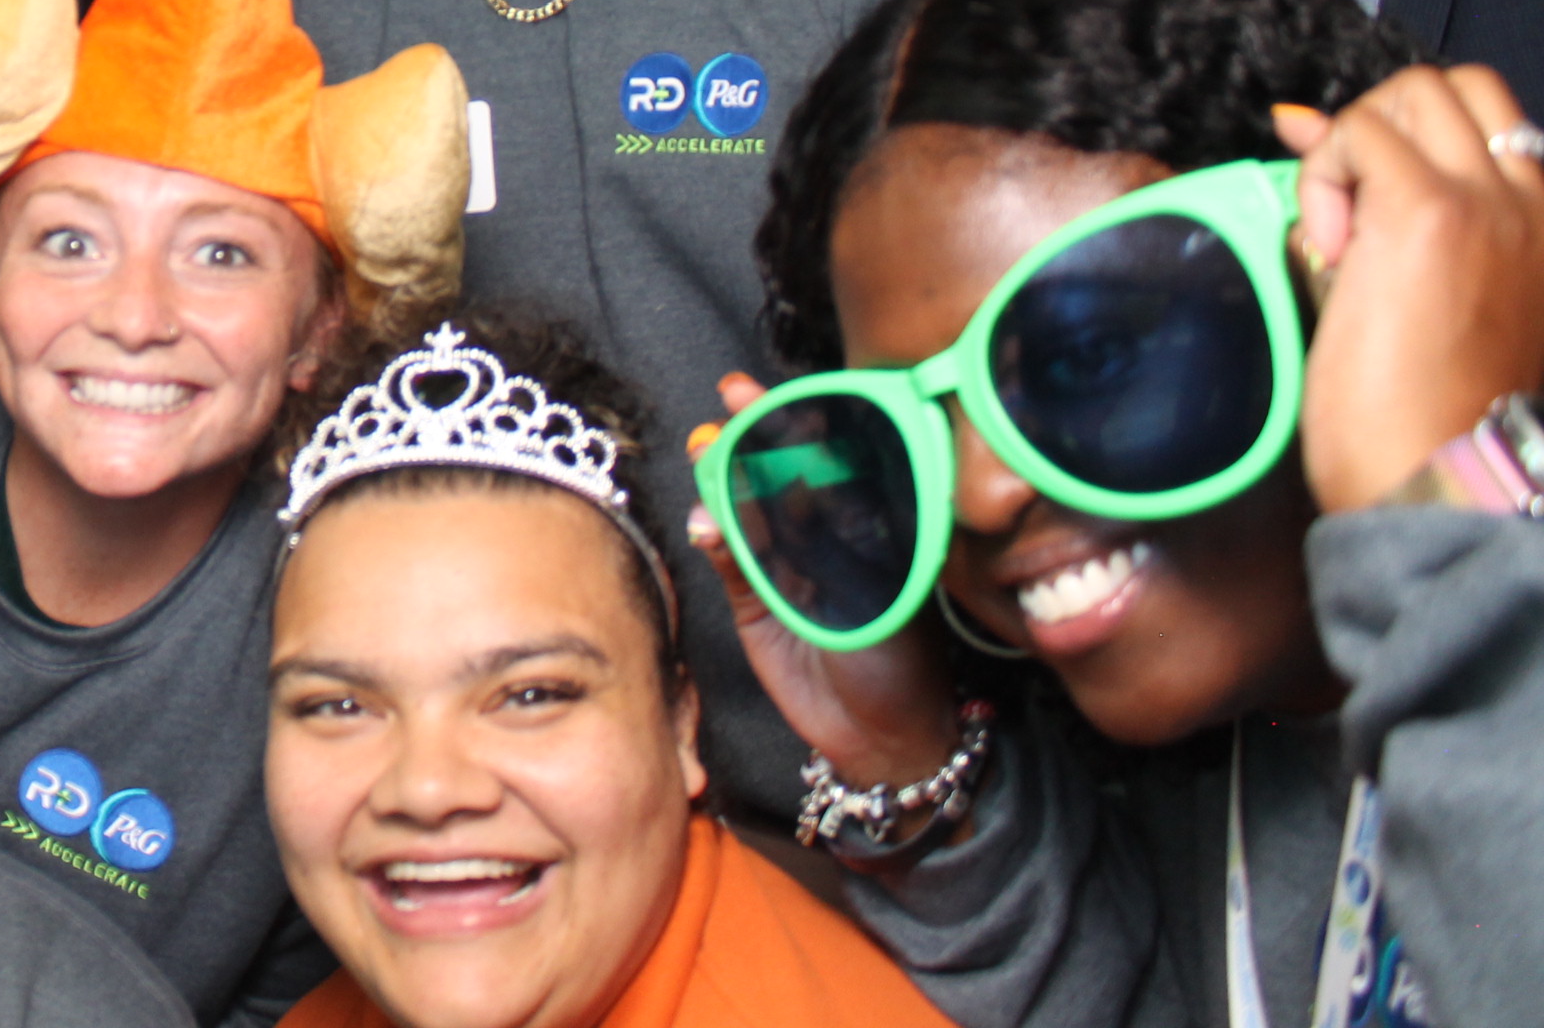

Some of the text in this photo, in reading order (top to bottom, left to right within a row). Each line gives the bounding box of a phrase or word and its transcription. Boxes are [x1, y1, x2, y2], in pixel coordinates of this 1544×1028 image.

[705, 79, 760, 108] P&G
[656, 137, 766, 154] ACCELERATE
[103, 813, 168, 856] P&G
